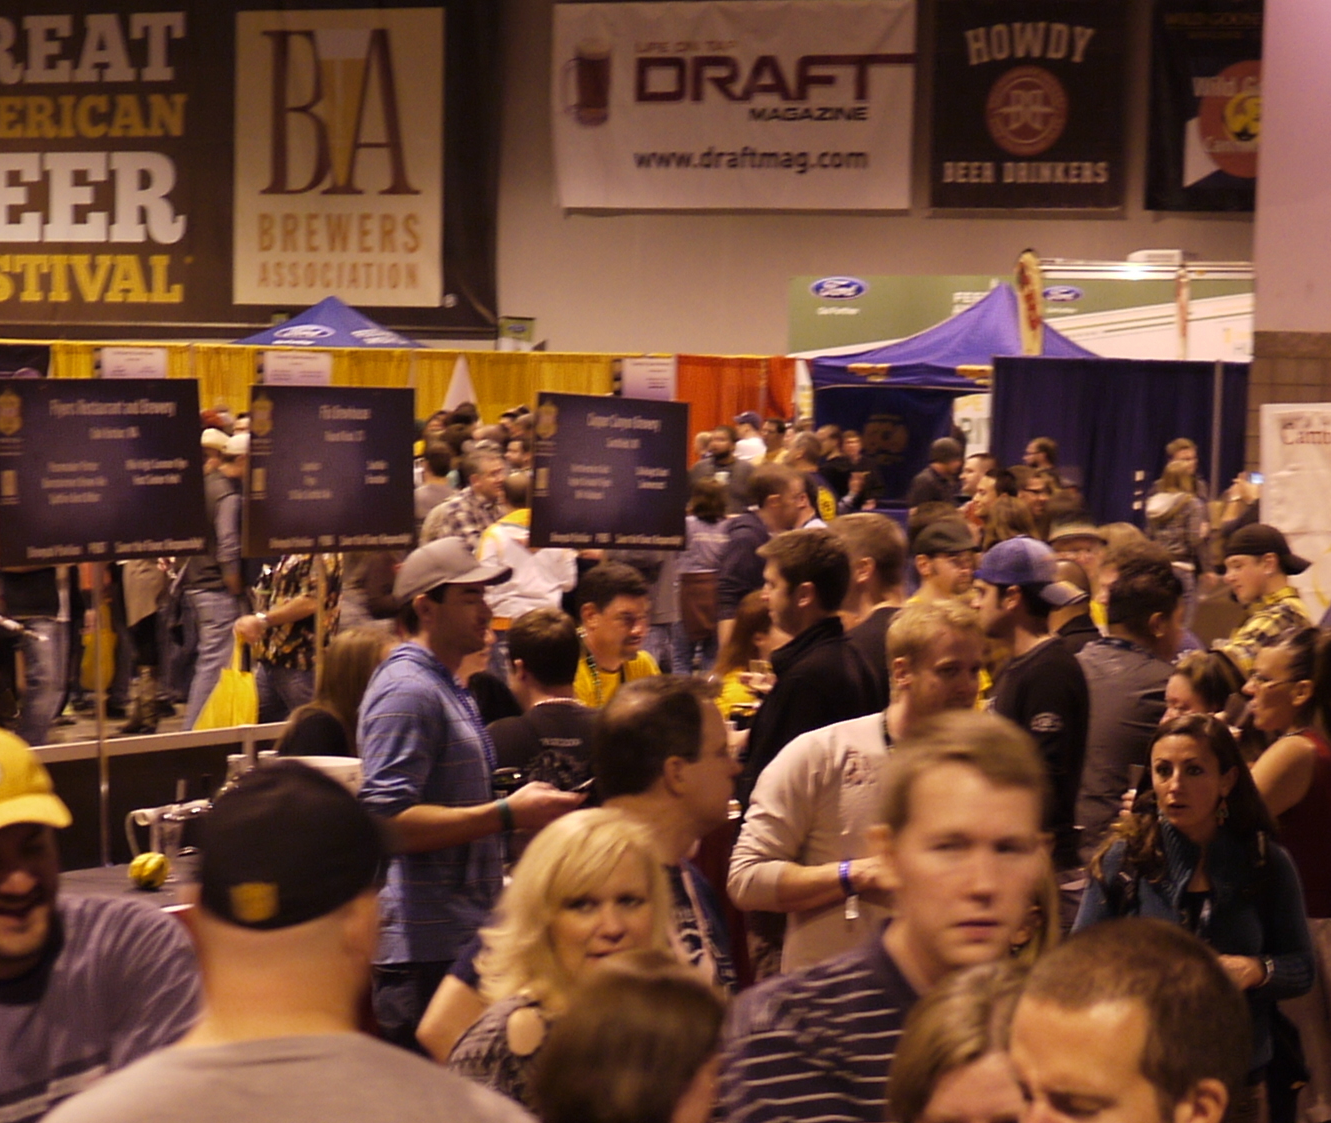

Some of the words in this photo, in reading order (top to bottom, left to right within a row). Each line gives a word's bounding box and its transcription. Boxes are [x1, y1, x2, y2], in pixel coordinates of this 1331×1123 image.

[964, 21, 1096, 65] HOWDY
[635, 53, 915, 103] DRAFT
[747, 106, 869, 122] MAGAZINE
[633, 146, 869, 176] www.draftmag.com
[942, 161, 996, 184] BEER
[1002, 161, 1110, 184] DRINKERS
[257, 211, 422, 254] BREWERS
[257, 260, 420, 290] ASSOCIATION
